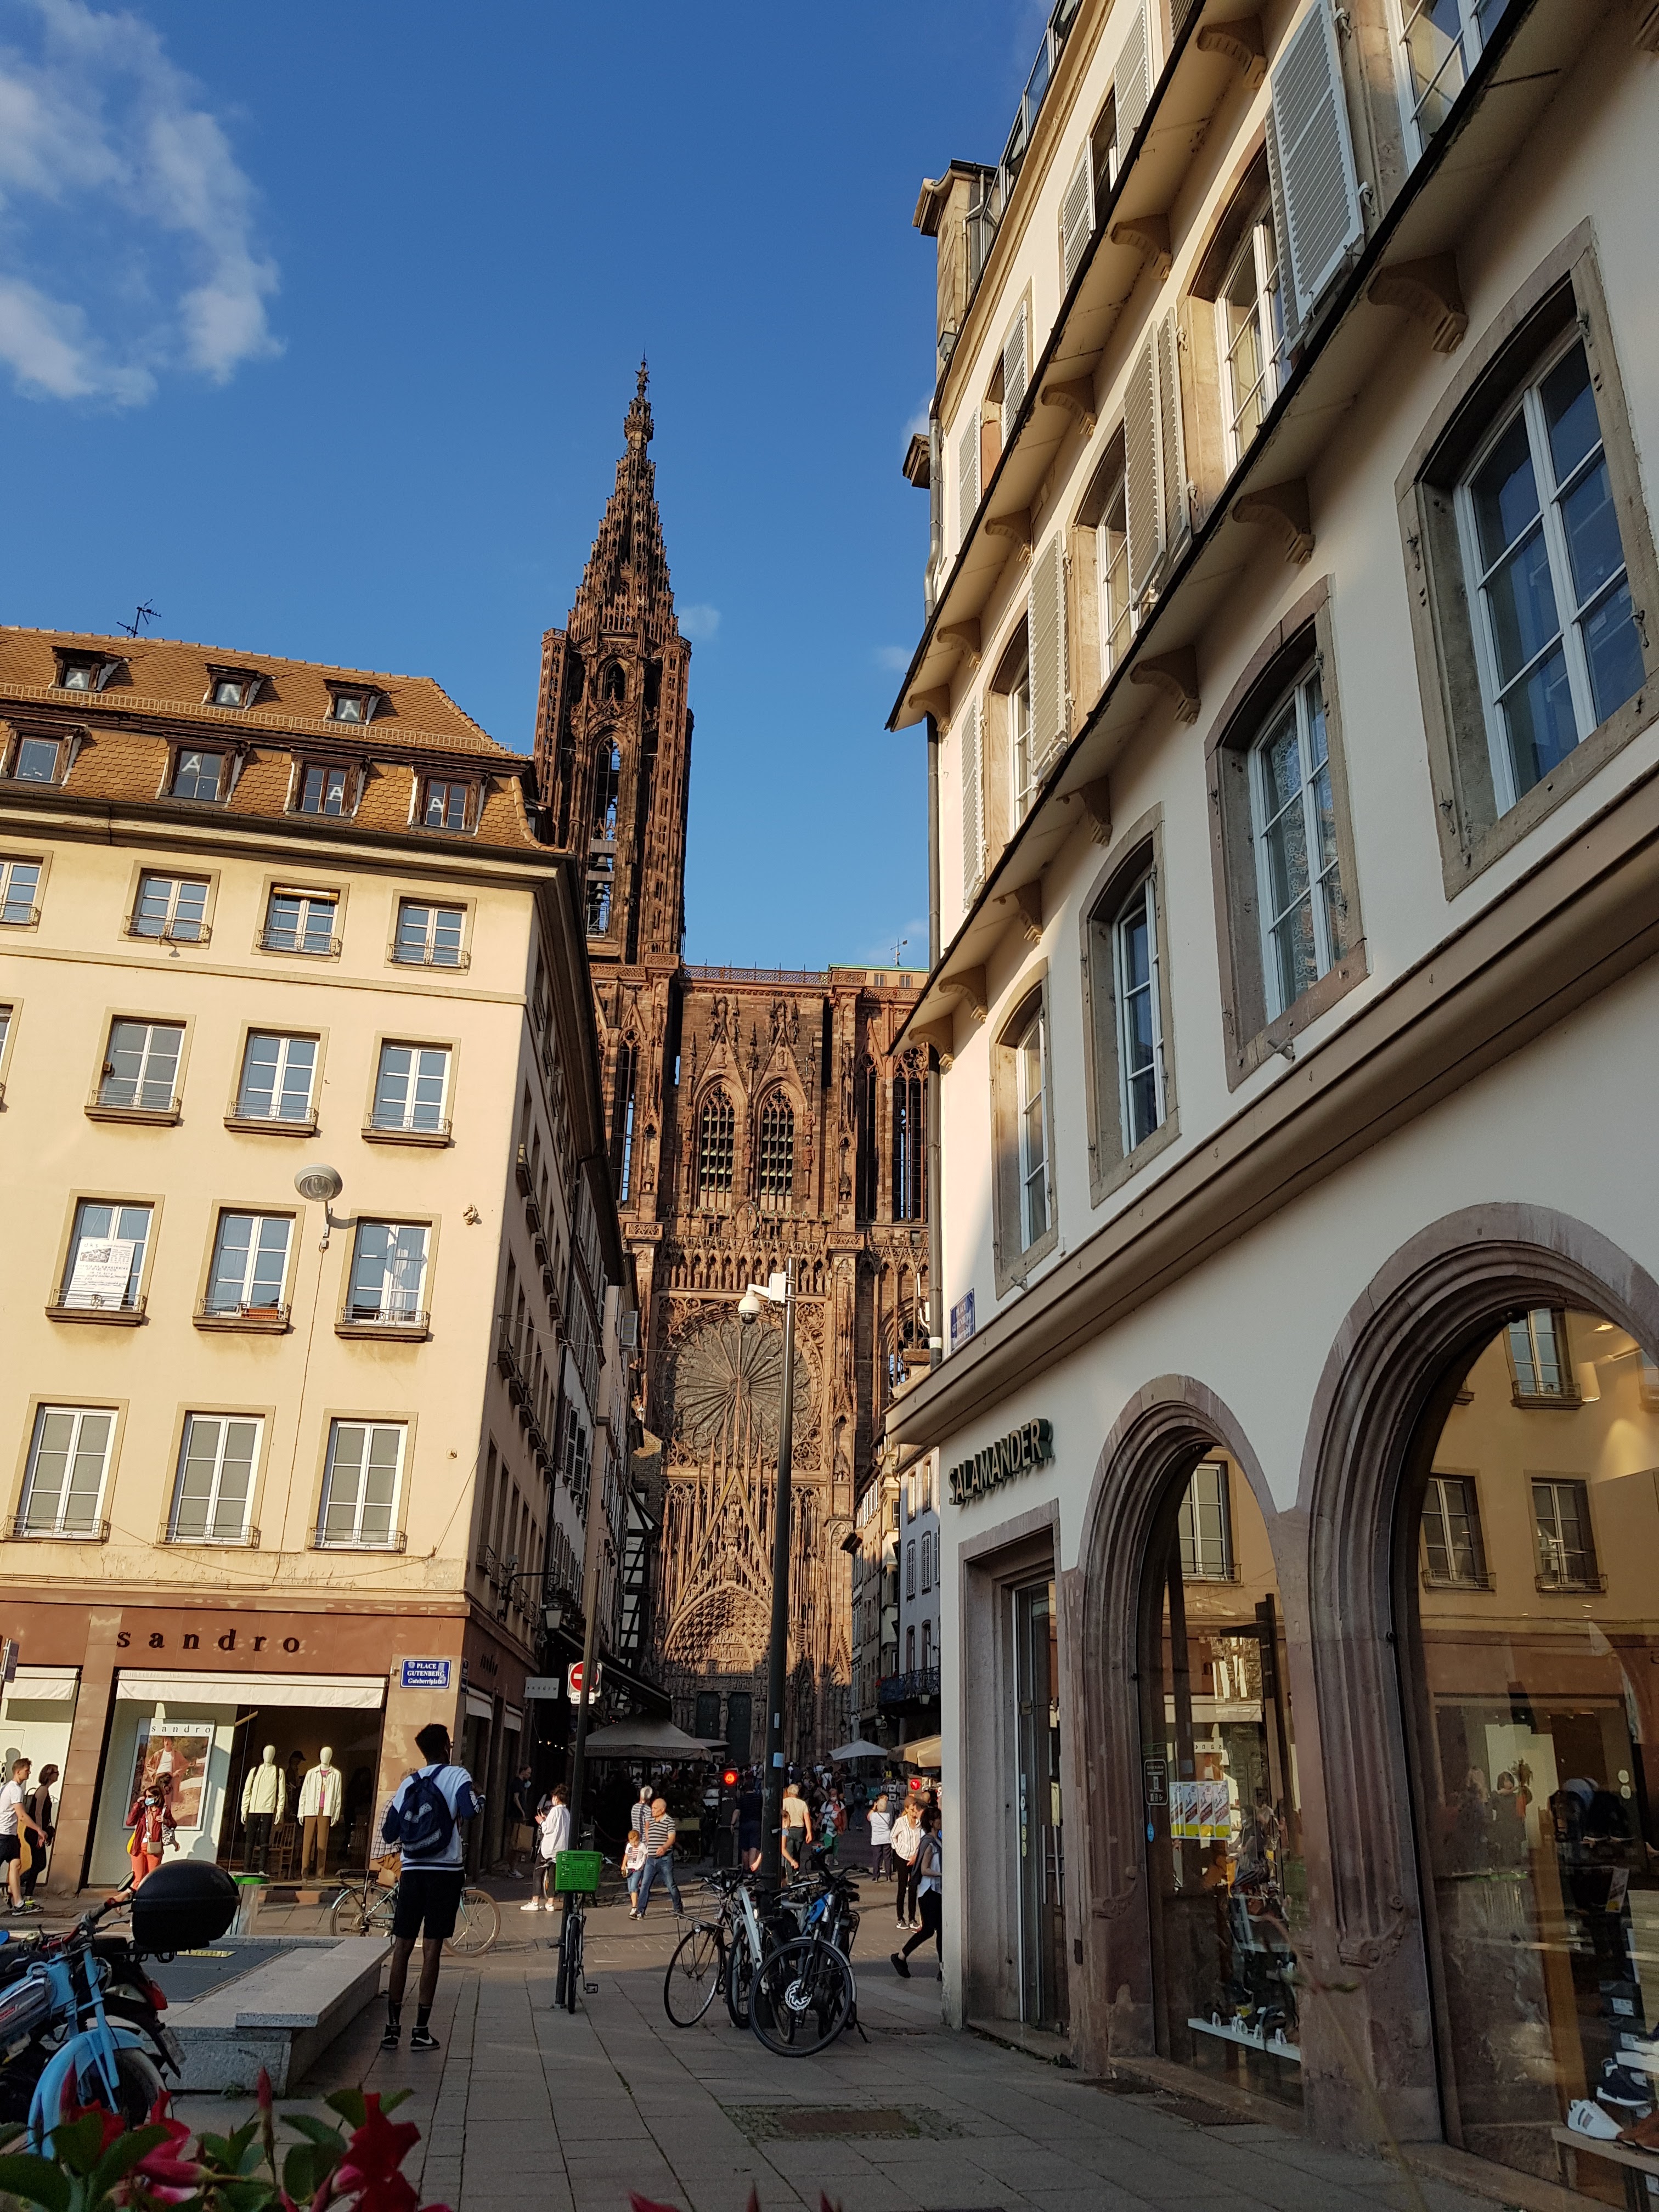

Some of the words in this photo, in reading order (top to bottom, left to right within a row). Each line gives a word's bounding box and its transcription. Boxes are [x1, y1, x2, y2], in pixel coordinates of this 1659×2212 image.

[948, 1418, 1052, 1505] SALAMANDER
[116, 1628, 300, 1653] sandro
[151, 1725, 211, 1734] sandro
